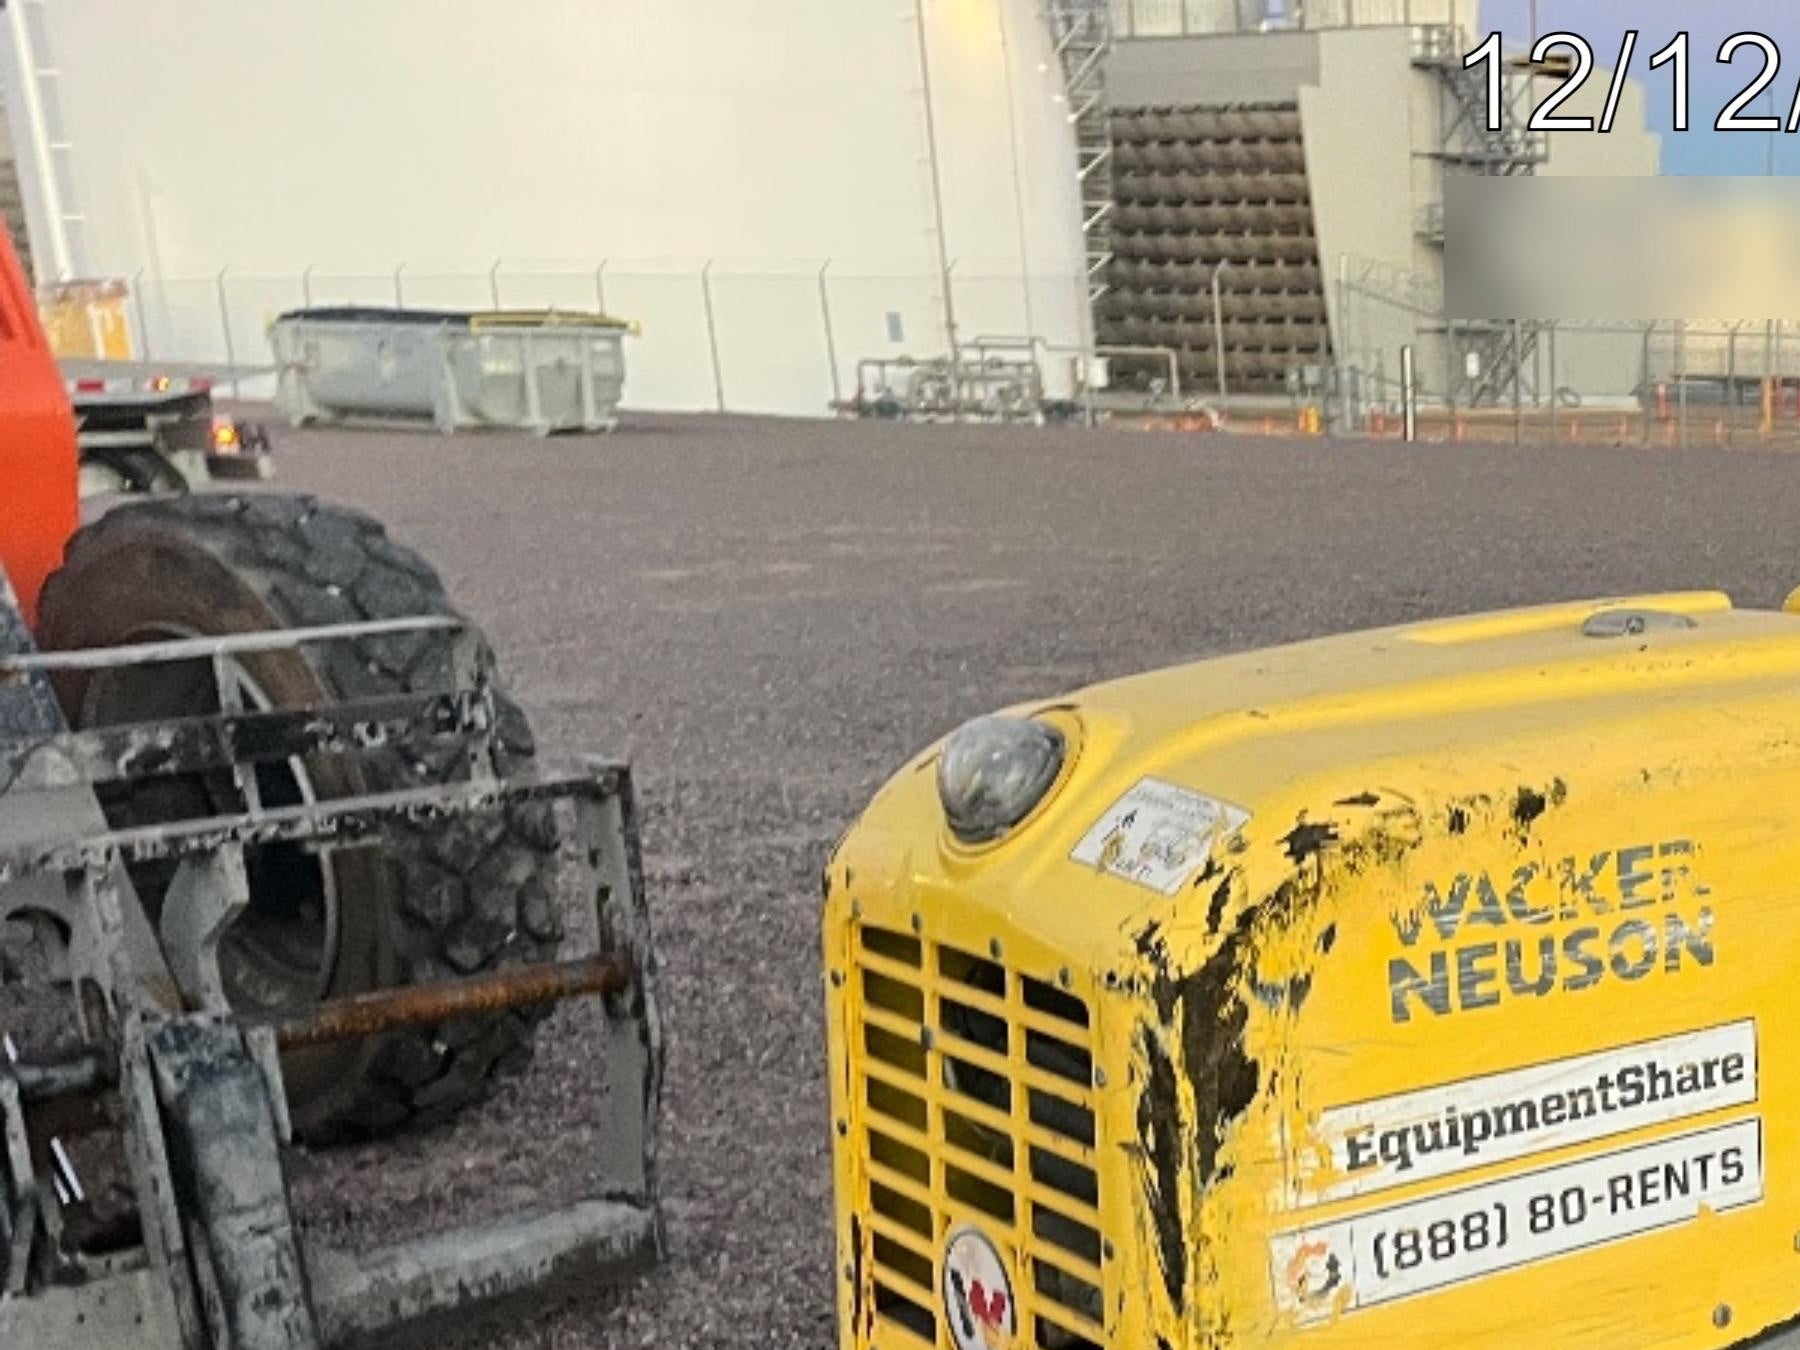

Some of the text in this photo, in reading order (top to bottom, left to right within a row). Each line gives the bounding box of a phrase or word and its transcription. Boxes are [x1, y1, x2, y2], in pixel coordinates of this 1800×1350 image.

[1388, 905, 1715, 1025] NEUSON
[1344, 1051, 1746, 1173] EquipmentShare
[1372, 1147, 1746, 1280] (888) 80-RENTS
